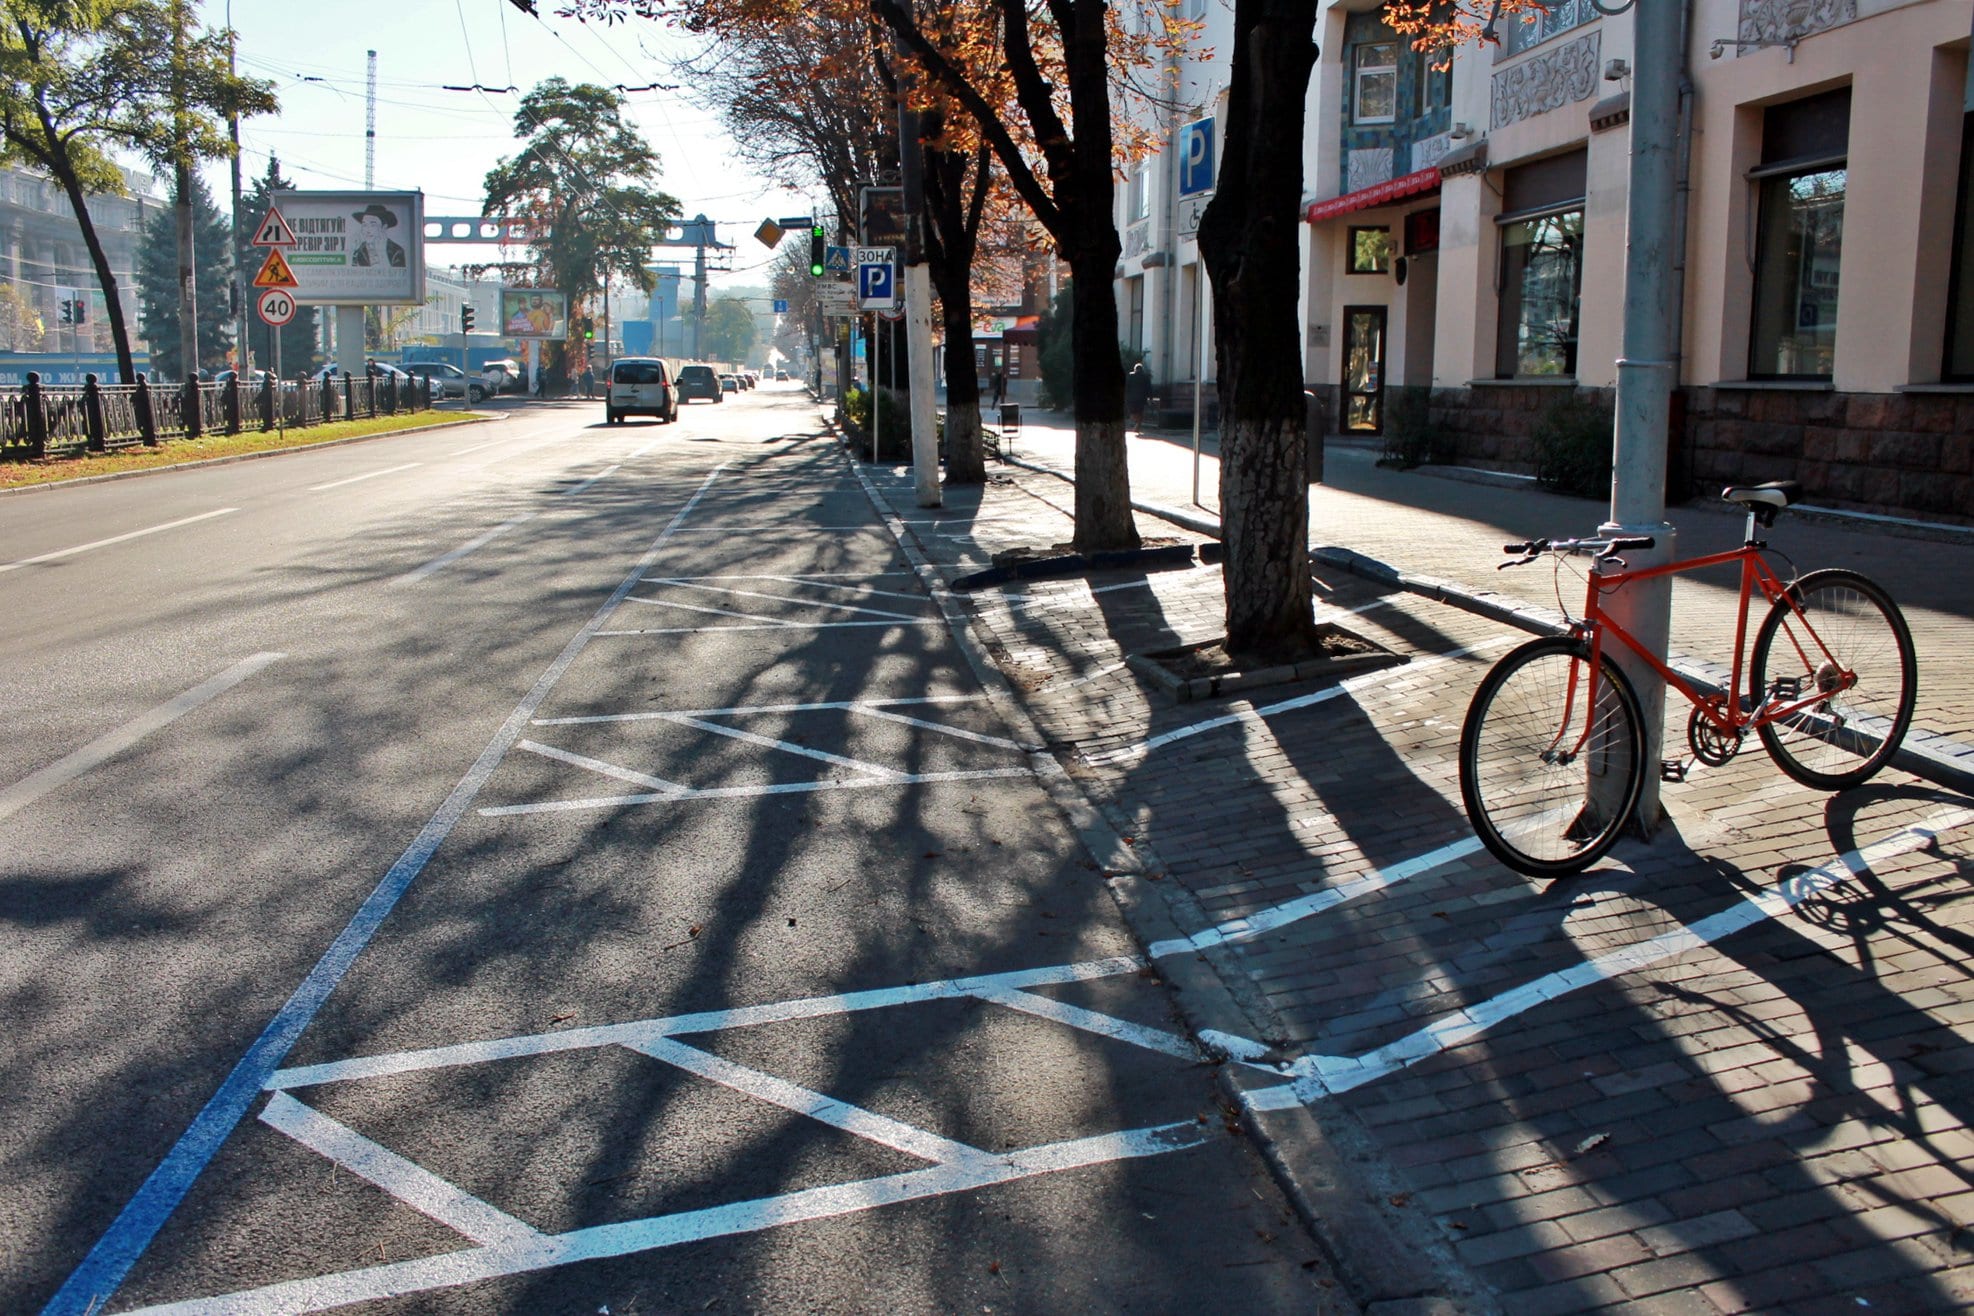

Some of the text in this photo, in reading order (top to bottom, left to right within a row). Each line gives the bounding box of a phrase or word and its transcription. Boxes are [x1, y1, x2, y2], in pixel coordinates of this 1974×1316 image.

[1187, 128, 1206, 188] P
[299, 216, 346, 234] ВІДТЯГУЙ!
[324, 236, 339, 251] ЗІР
[340, 236, 346, 251] У
[859, 251, 894, 262] ЗОНА
[868, 267, 886, 296] P
[265, 300, 289, 316] 40
